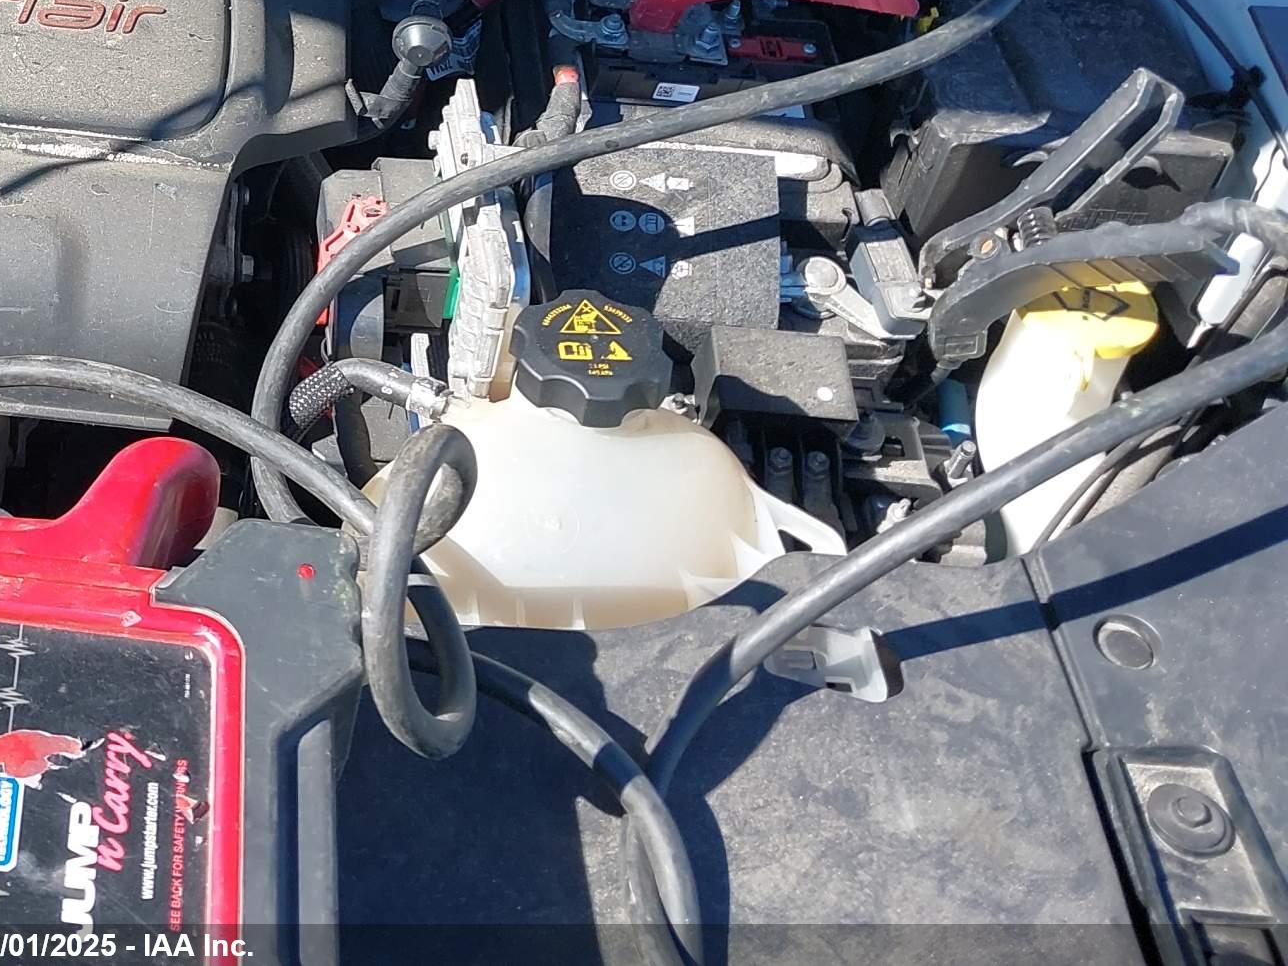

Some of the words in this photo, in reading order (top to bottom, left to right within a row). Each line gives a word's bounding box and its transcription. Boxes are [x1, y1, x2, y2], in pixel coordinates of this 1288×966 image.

[141, 781, 160, 900] www.jumpstarter.com
[173, 815, 186, 853] SAFETY
[61, 801, 100, 942] JUMP
[172, 854, 185, 877] FOR
[171, 879, 183, 909] BACK
[170, 910, 182, 932] SEE
